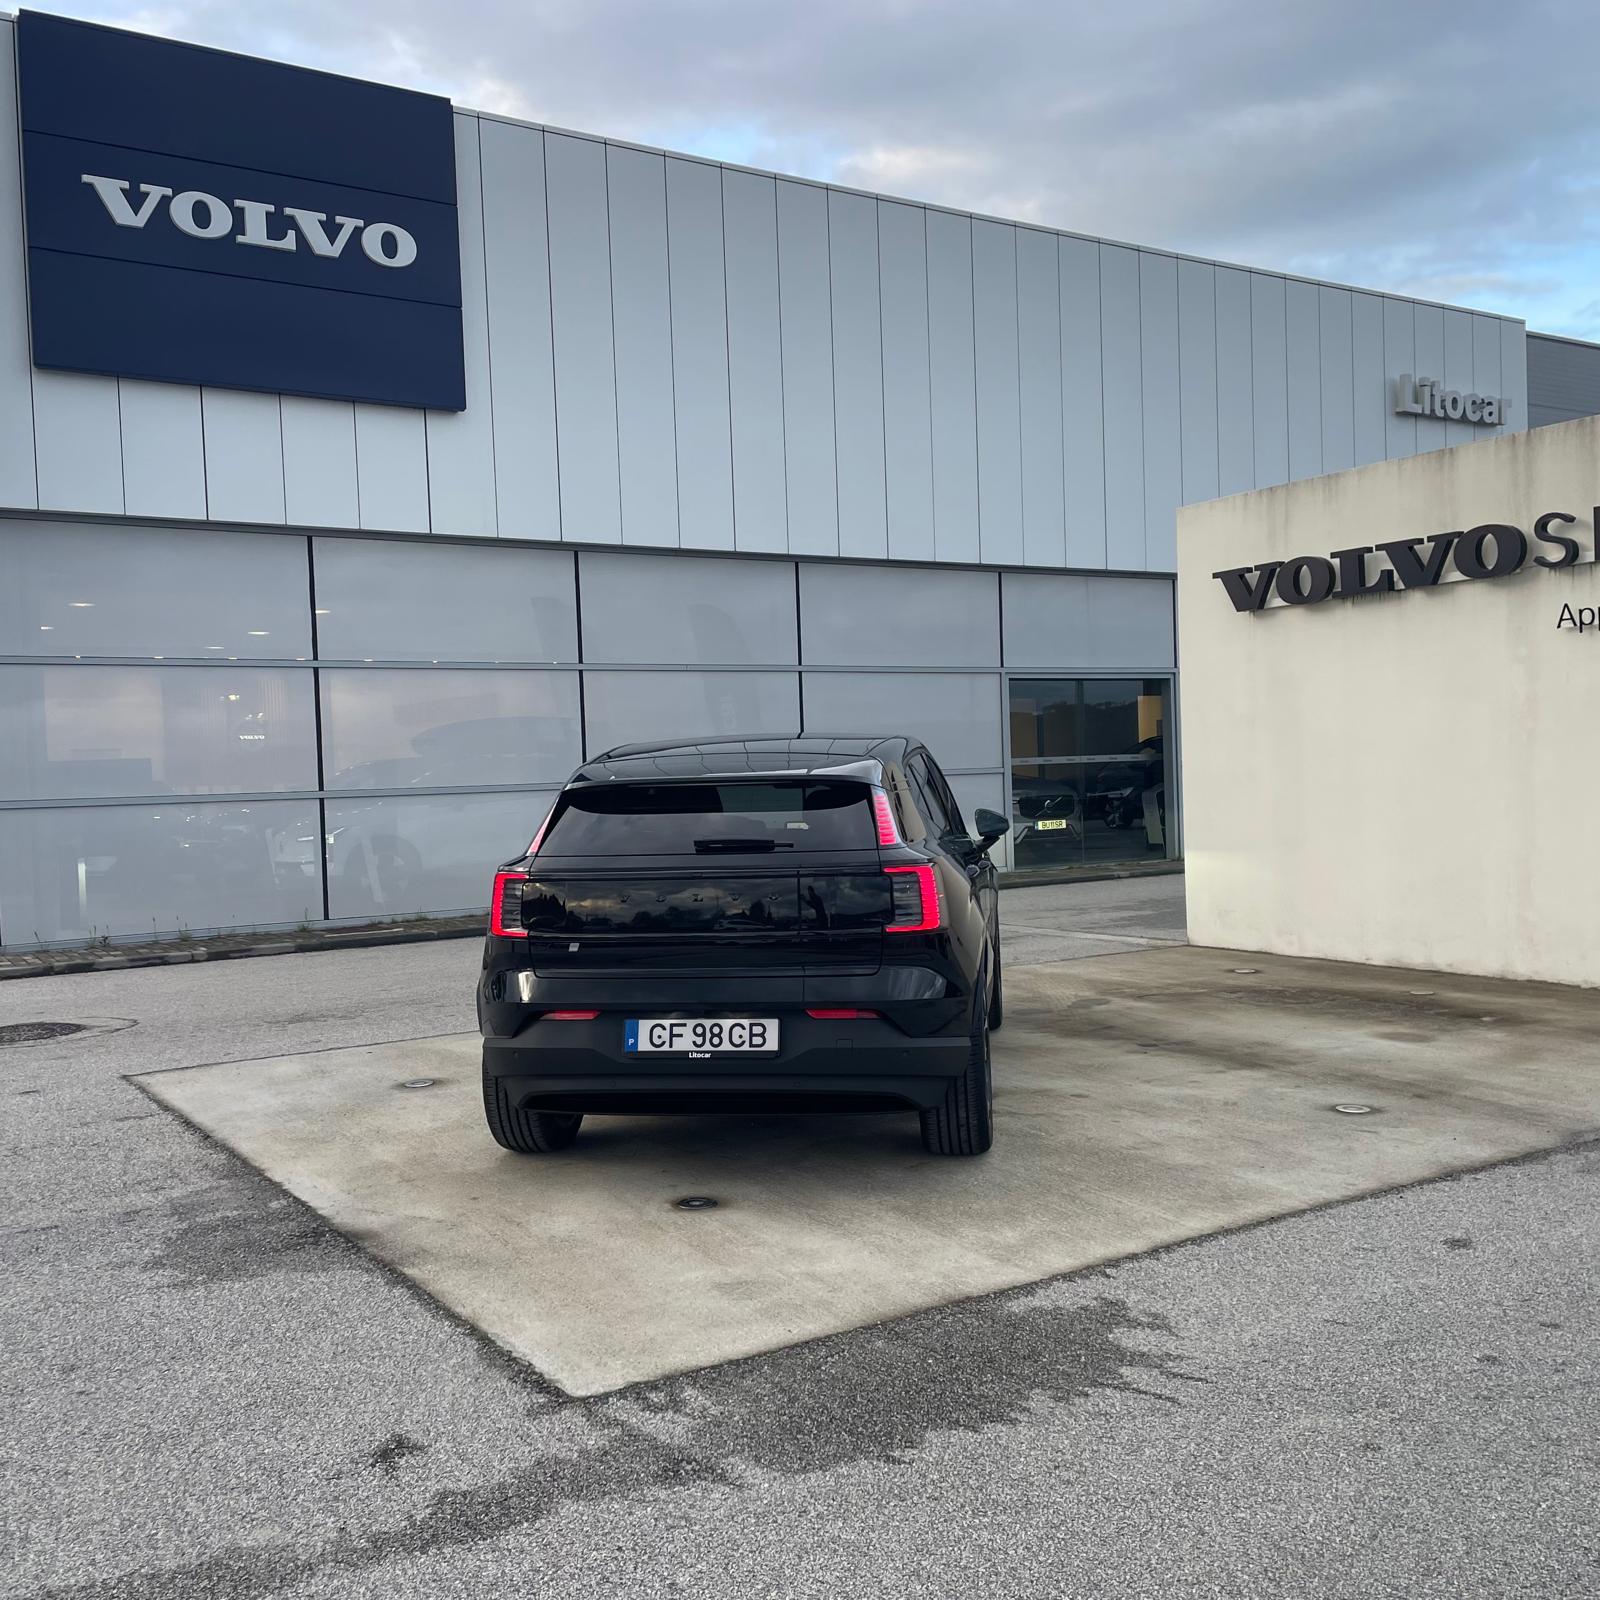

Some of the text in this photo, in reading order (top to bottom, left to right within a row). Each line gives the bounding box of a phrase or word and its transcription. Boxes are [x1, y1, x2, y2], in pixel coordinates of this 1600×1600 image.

[81, 174, 417, 268] VOLVO
[1394, 373, 1512, 426] Litocar
[1212, 506, 1600, 612] VOLVO S
[1557, 603, 1600, 633] Ap
